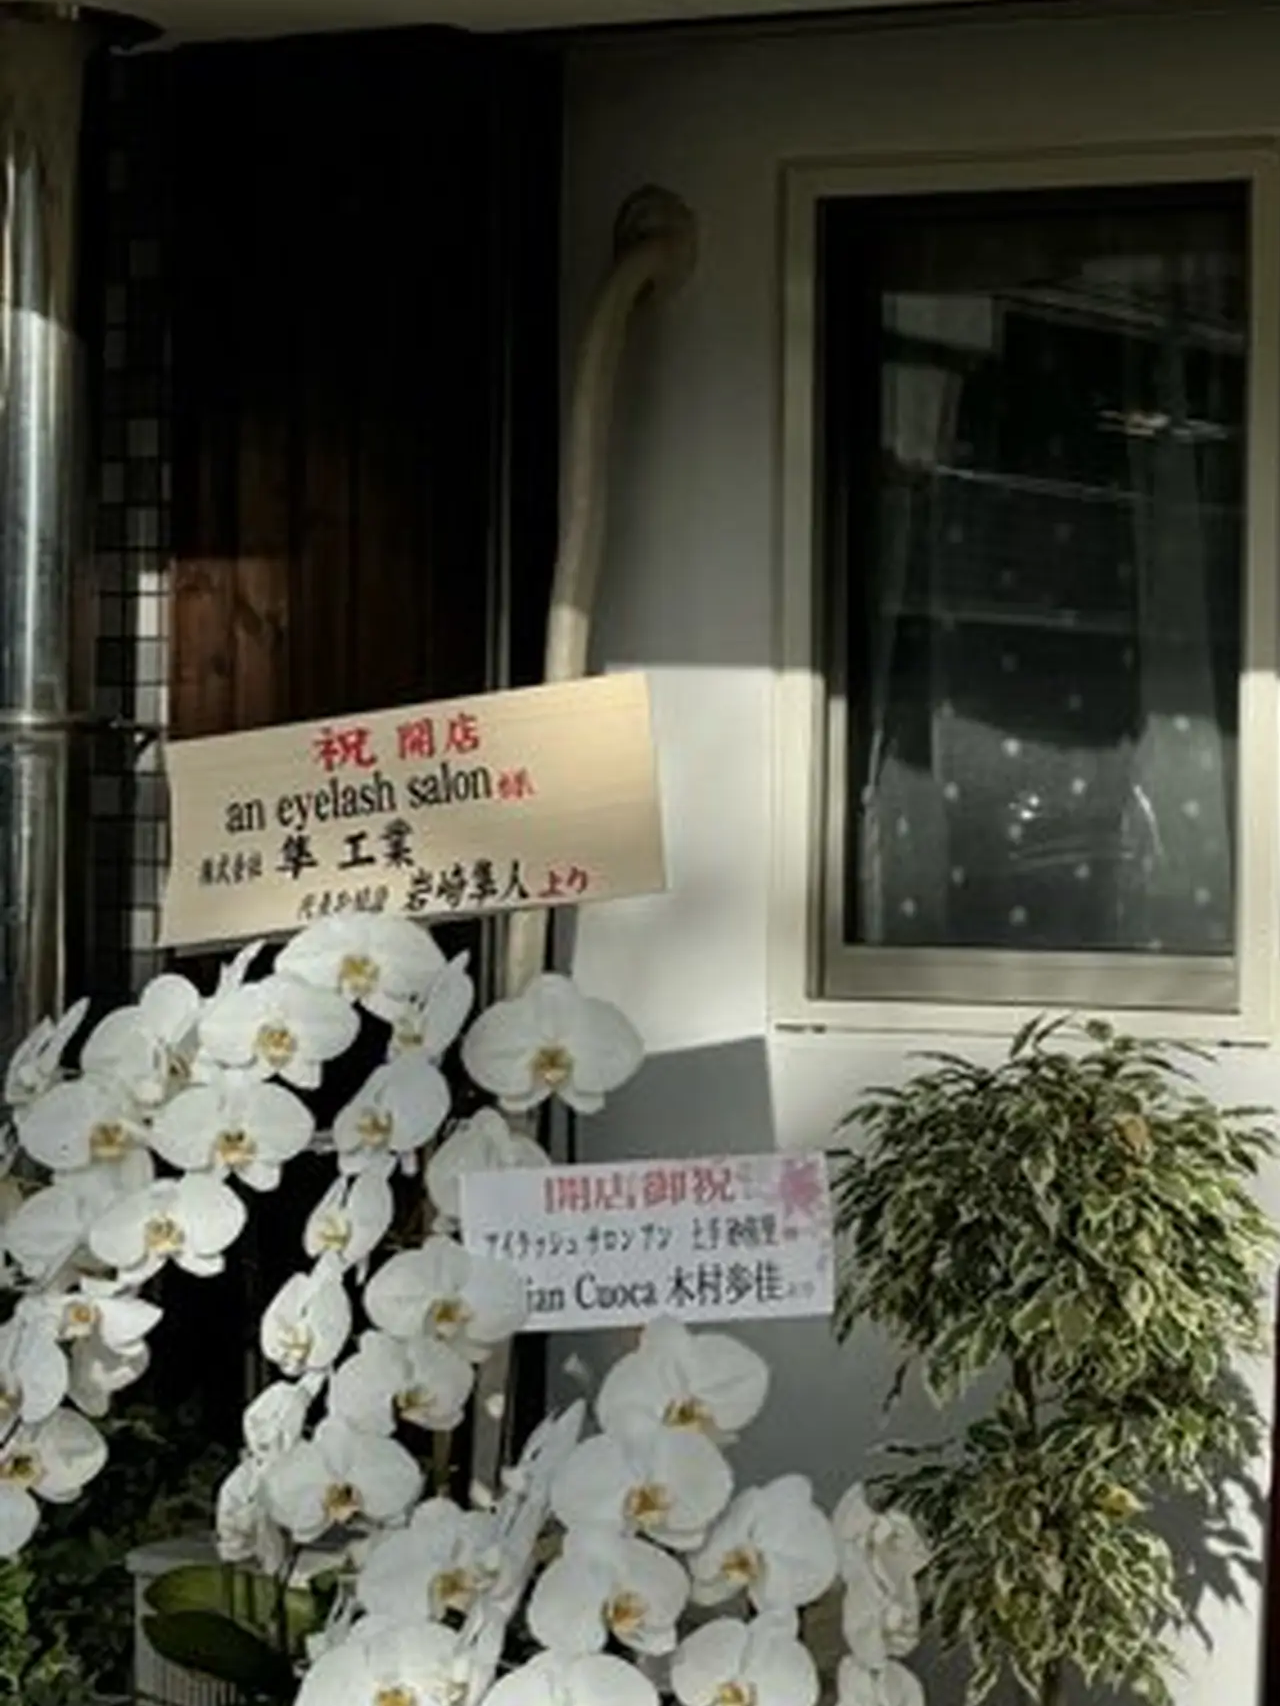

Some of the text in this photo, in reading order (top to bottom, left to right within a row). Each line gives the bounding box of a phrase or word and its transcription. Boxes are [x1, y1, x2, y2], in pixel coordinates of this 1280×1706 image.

[225, 798, 266, 834] an
[277, 769, 396, 831] eyelash
[408, 762, 492, 807] salon
[543, 1165, 736, 1214] 開店御祝
